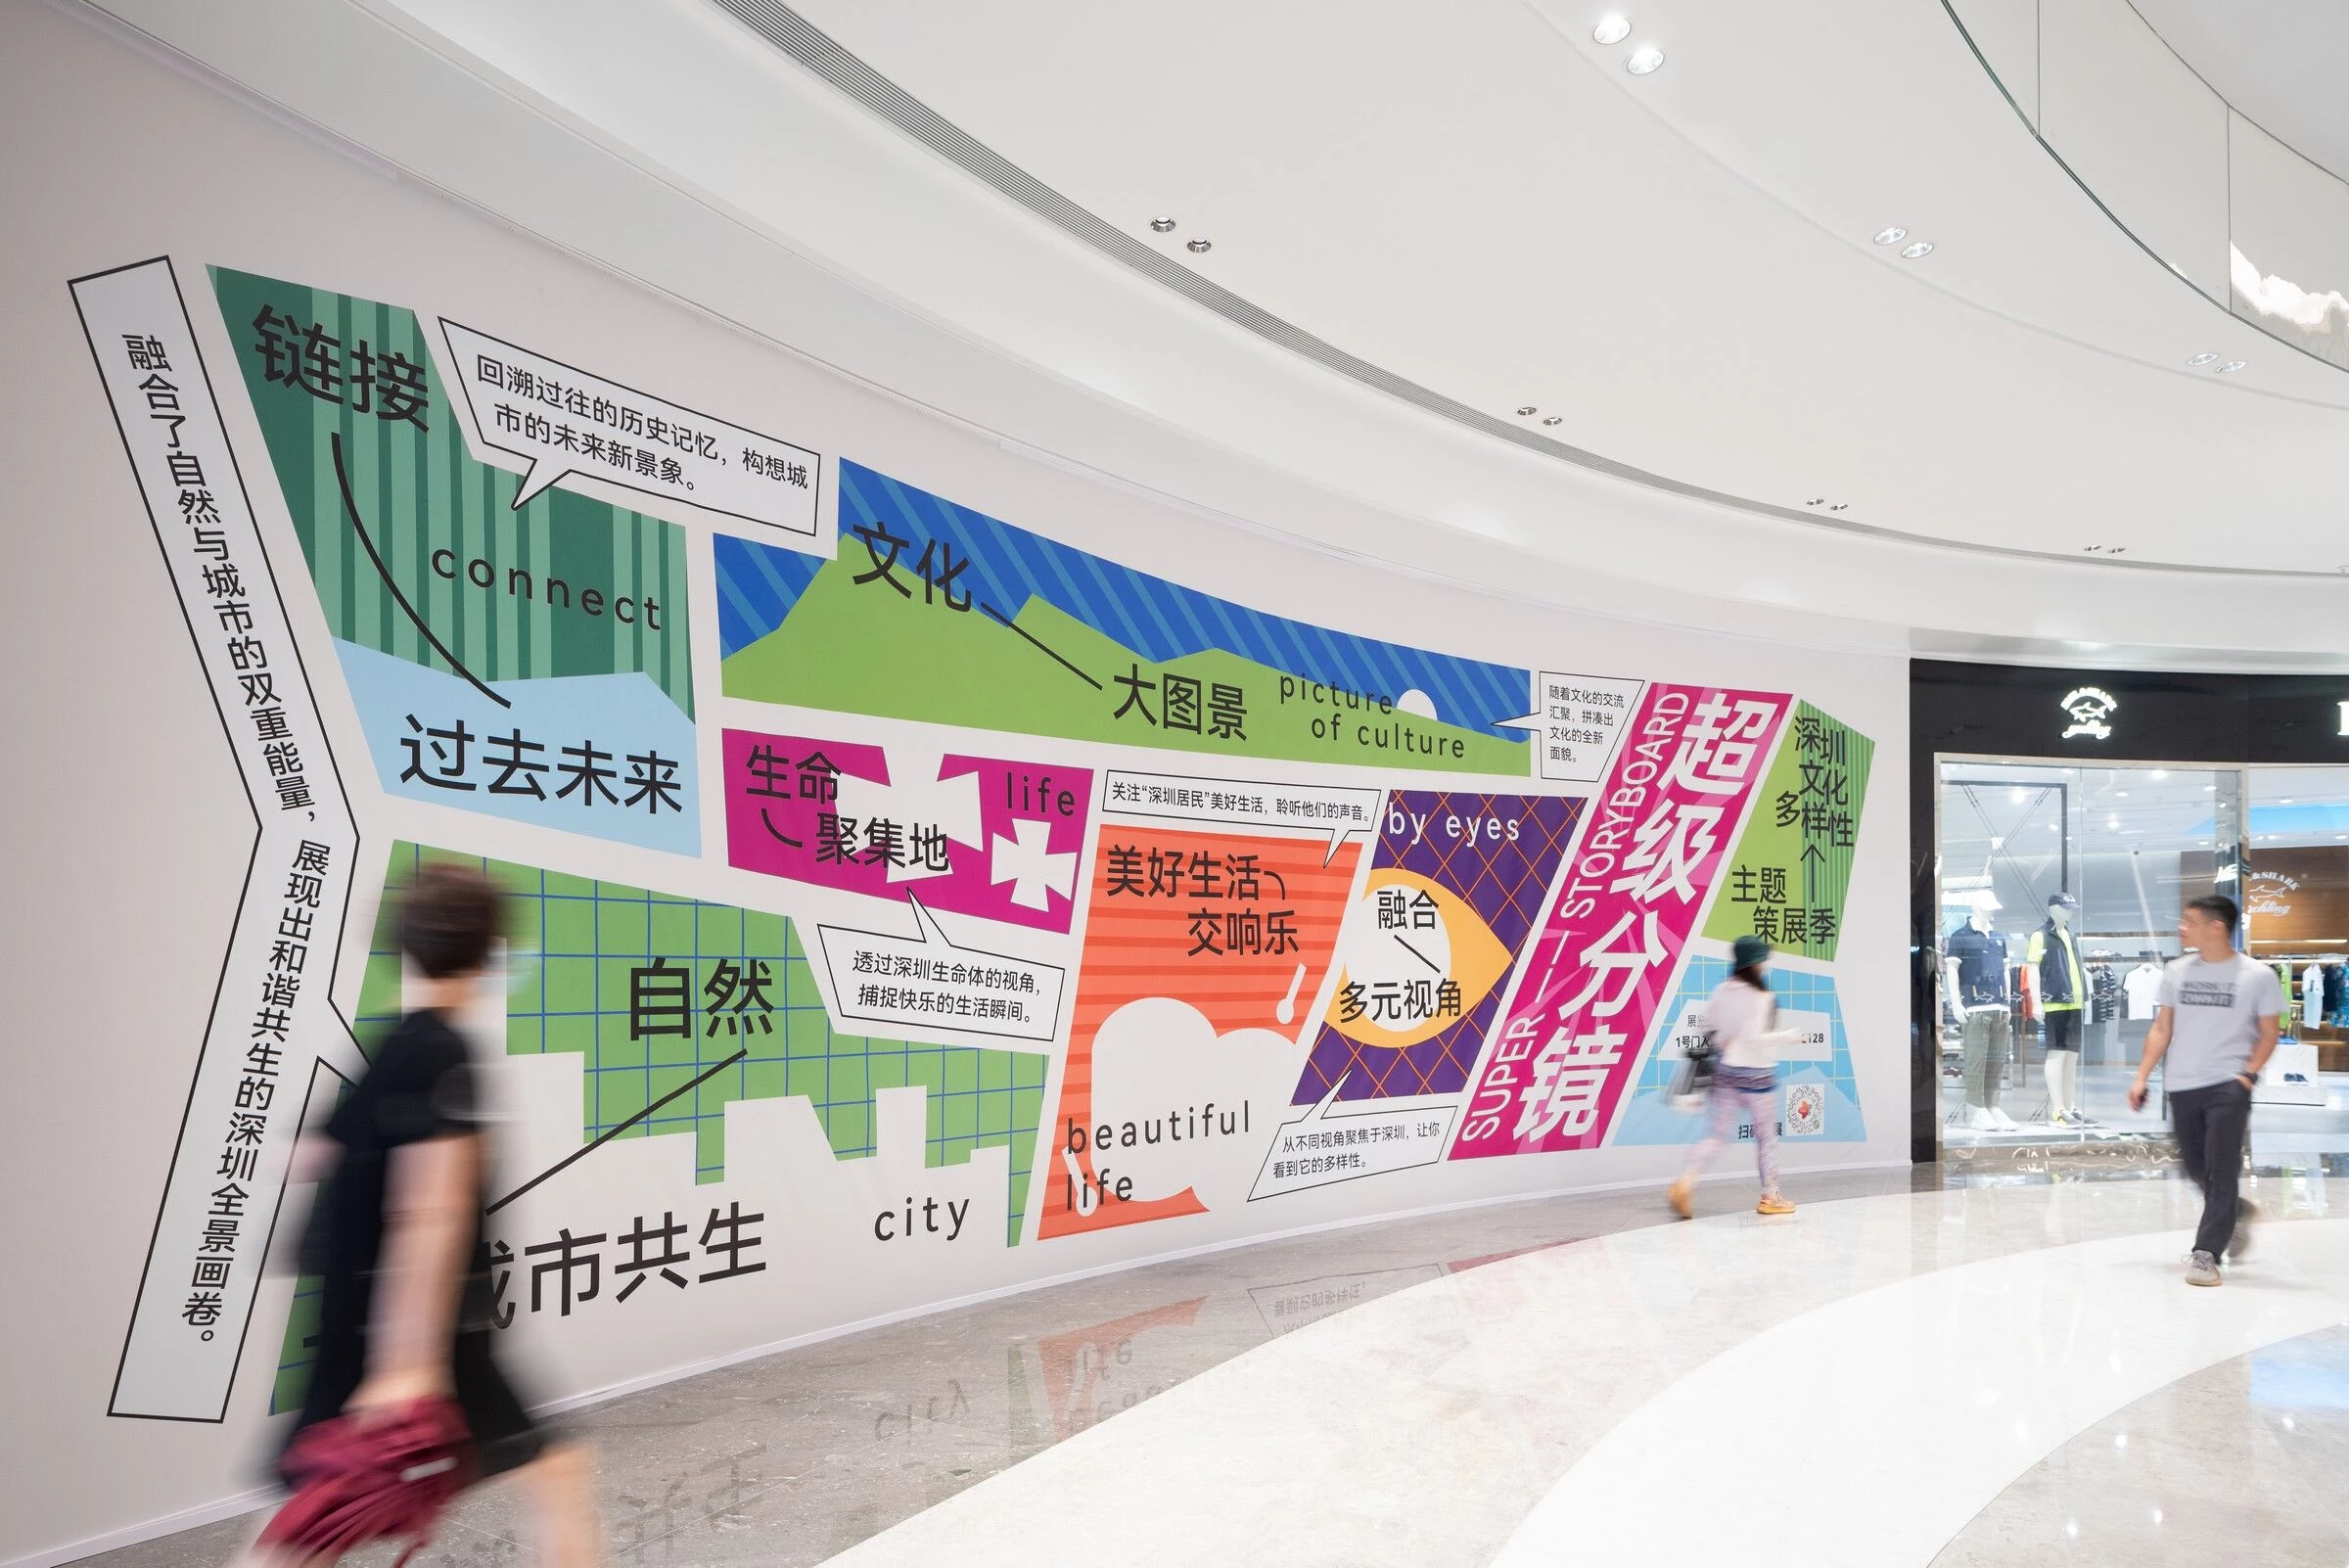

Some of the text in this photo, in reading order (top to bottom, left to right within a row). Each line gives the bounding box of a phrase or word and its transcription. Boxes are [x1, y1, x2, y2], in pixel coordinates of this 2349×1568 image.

[252, 302, 429, 434] 链接
[478, 353, 807, 489] 回溯过往的历史记忆，构想城
[494, 403, 694, 490] 市的未来新景象。
[432, 548, 661, 630] connect
[852, 522, 972, 613] 文化
[1113, 664, 1247, 741] 大图景
[1280, 673, 1392, 715] picture
[1549, 685, 1625, 709] 随着文化的交流
[1549, 706, 1613, 726] 汇聚，拼凑出
[1312, 715, 1465, 759] of culture
[1550, 726, 1603, 745] 文化的全新
[1550, 746, 1577, 762] 面貌。
[1794, 716, 1846, 766] 深圳
[399, 714, 683, 814] 过去未来
[745, 744, 842, 806] 生命
[1799, 760, 1849, 807] 文化
[1006, 771, 1076, 816] life
[815, 811, 949, 872] 聚集地
[1388, 802, 1519, 848] by eyes
[1775, 791, 1854, 848] 多样性
[1107, 844, 1261, 900] 美好生活
[1731, 864, 1786, 903] 主题
[1187, 907, 1300, 956] 交响乐
[1377, 889, 1439, 930] 融合
[1462, 691, 1688, 1142] SUPER STORYBOARD
[1513, 692, 1779, 1143] 超级分镜
[1753, 906, 1835, 945] 策展季
[852, 949, 1041, 996] 透过深圳生命体的视角，
[628, 956, 774, 1041] 自然
[857, 984, 1032, 1024] 捕捉快乐的生活瞬间。
[1339, 978, 1461, 1023] 多元视角
[182, 839, 330, 1343] 展现出和谐共生的深圳全景画卷。
[1067, 1100, 1250, 1155] beautiful
[1282, 1122, 1441, 1154] 从不同视角聚焦于深圳，让你
[1272, 1152, 1366, 1178] 看到它的多样性。
[1067, 1173, 1132, 1211] life
[874, 1196, 970, 1241] city
